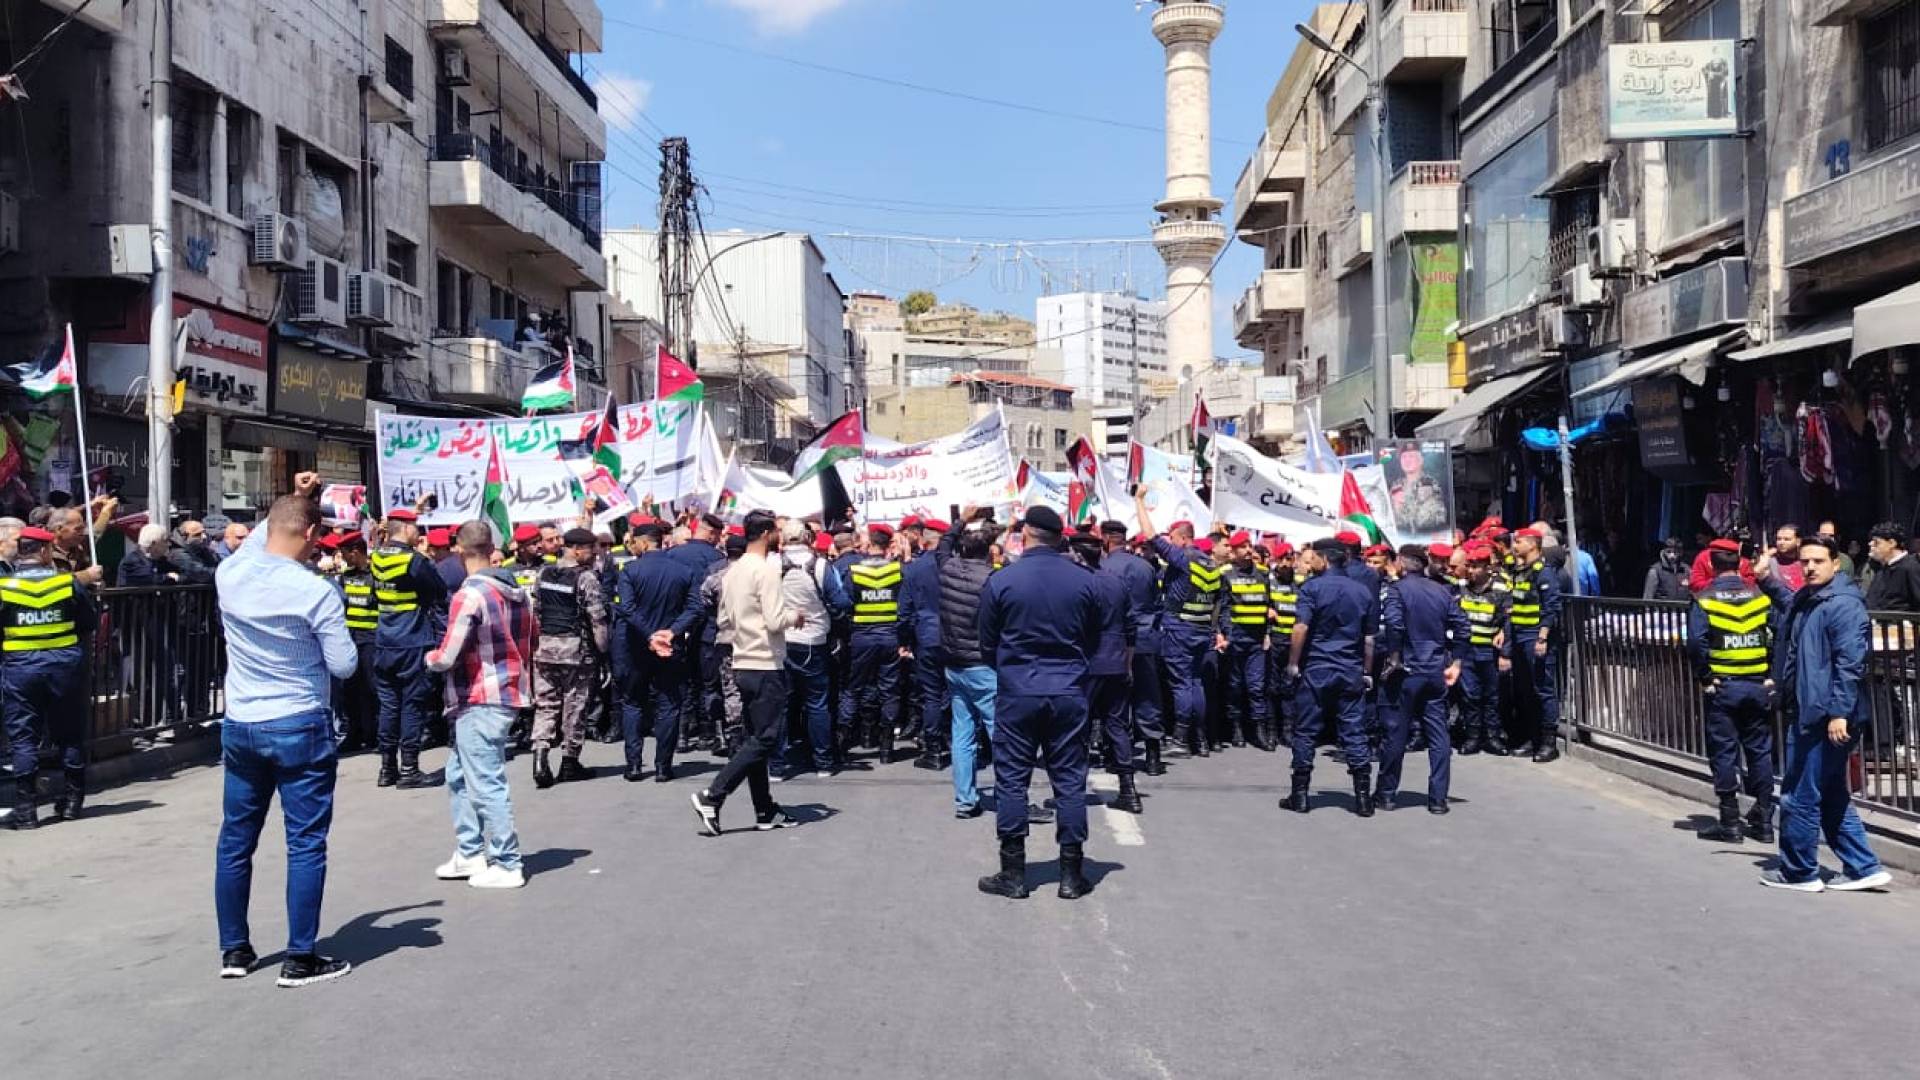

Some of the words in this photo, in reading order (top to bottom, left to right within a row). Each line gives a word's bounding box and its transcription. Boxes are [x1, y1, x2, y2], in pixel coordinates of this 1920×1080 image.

[86, 443, 129, 468] nfinix
[861, 589, 893, 602] POLICE
[17, 609, 62, 625] POLICE
[1724, 633, 1761, 650] POLICE
